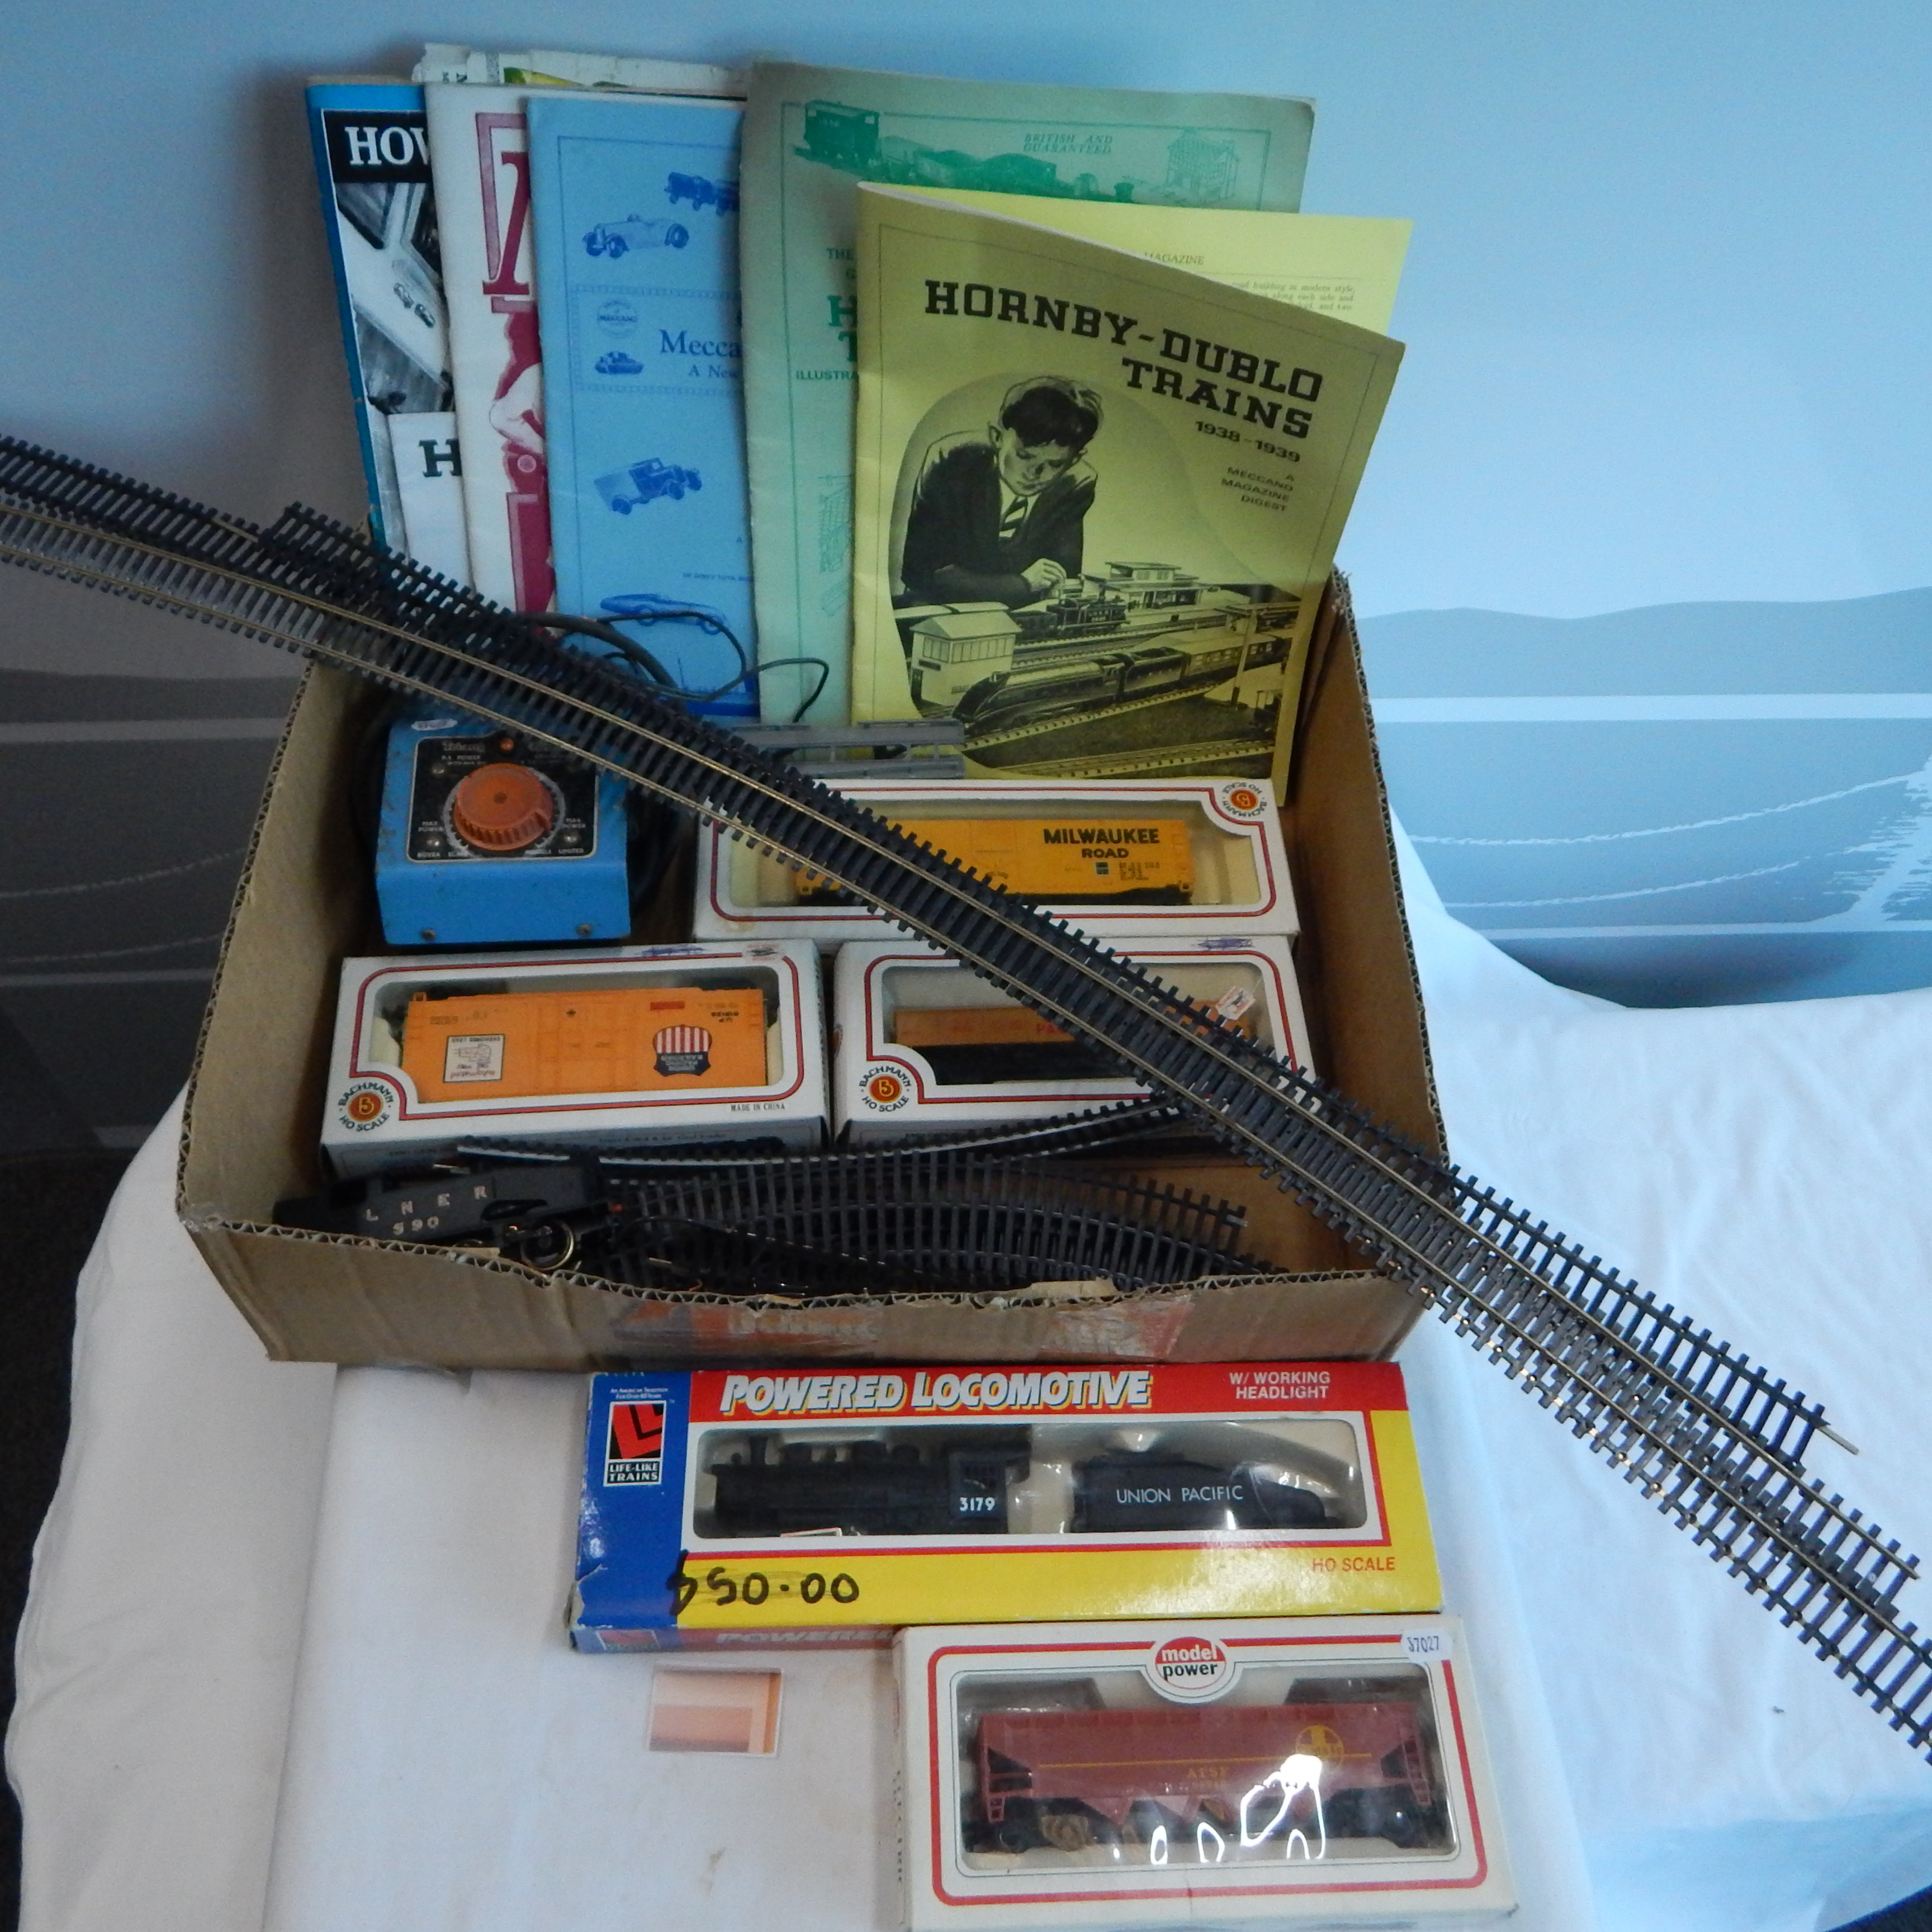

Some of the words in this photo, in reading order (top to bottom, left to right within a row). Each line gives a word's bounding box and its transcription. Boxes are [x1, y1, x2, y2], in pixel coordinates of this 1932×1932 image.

[659, 329, 742, 358] Mecca
[925, 280, 1323, 403] HORNBY-DUBLO
[688, 364, 700, 377] A
[1121, 357, 1313, 439] TRAINS
[419, 438, 462, 477] H
[1227, 466, 1293, 491] MECCANO
[1221, 477, 1290, 502] MAGAZINE
[1240, 494, 1286, 511] DIGEST
[1043, 828, 1160, 844] MILWAUKEE
[1081, 847, 1129, 858] ROAD
[859, 1066, 912, 1088] BACHMANN
[338, 1082, 394, 1106] BACHMANN
[861, 1096, 877, 1110] HO
[879, 1095, 910, 1112] SCALE
[338, 1116, 355, 1130] HO
[356, 1112, 390, 1131] SCALE
[1229, 1371, 1249, 1385] W/
[1253, 1371, 1331, 1385] WORKING
[719, 1374, 906, 1415] POWERED
[911, 1371, 1154, 1412] LOCOMOTIVE
[1235, 1386, 1329, 1399] HEADLIGHT
[609, 1473, 658, 1481] TRAINS
[1116, 1488, 1171, 1504] UNION
[1181, 1485, 1243, 1502] PACIFIC
[959, 1497, 996, 1512] 3179
[1312, 1557, 1337, 1572] HO
[1341, 1556, 1396, 1571] SCALE
[1161, 1640, 1218, 1662] model
[1162, 1663, 1218, 1682] power
